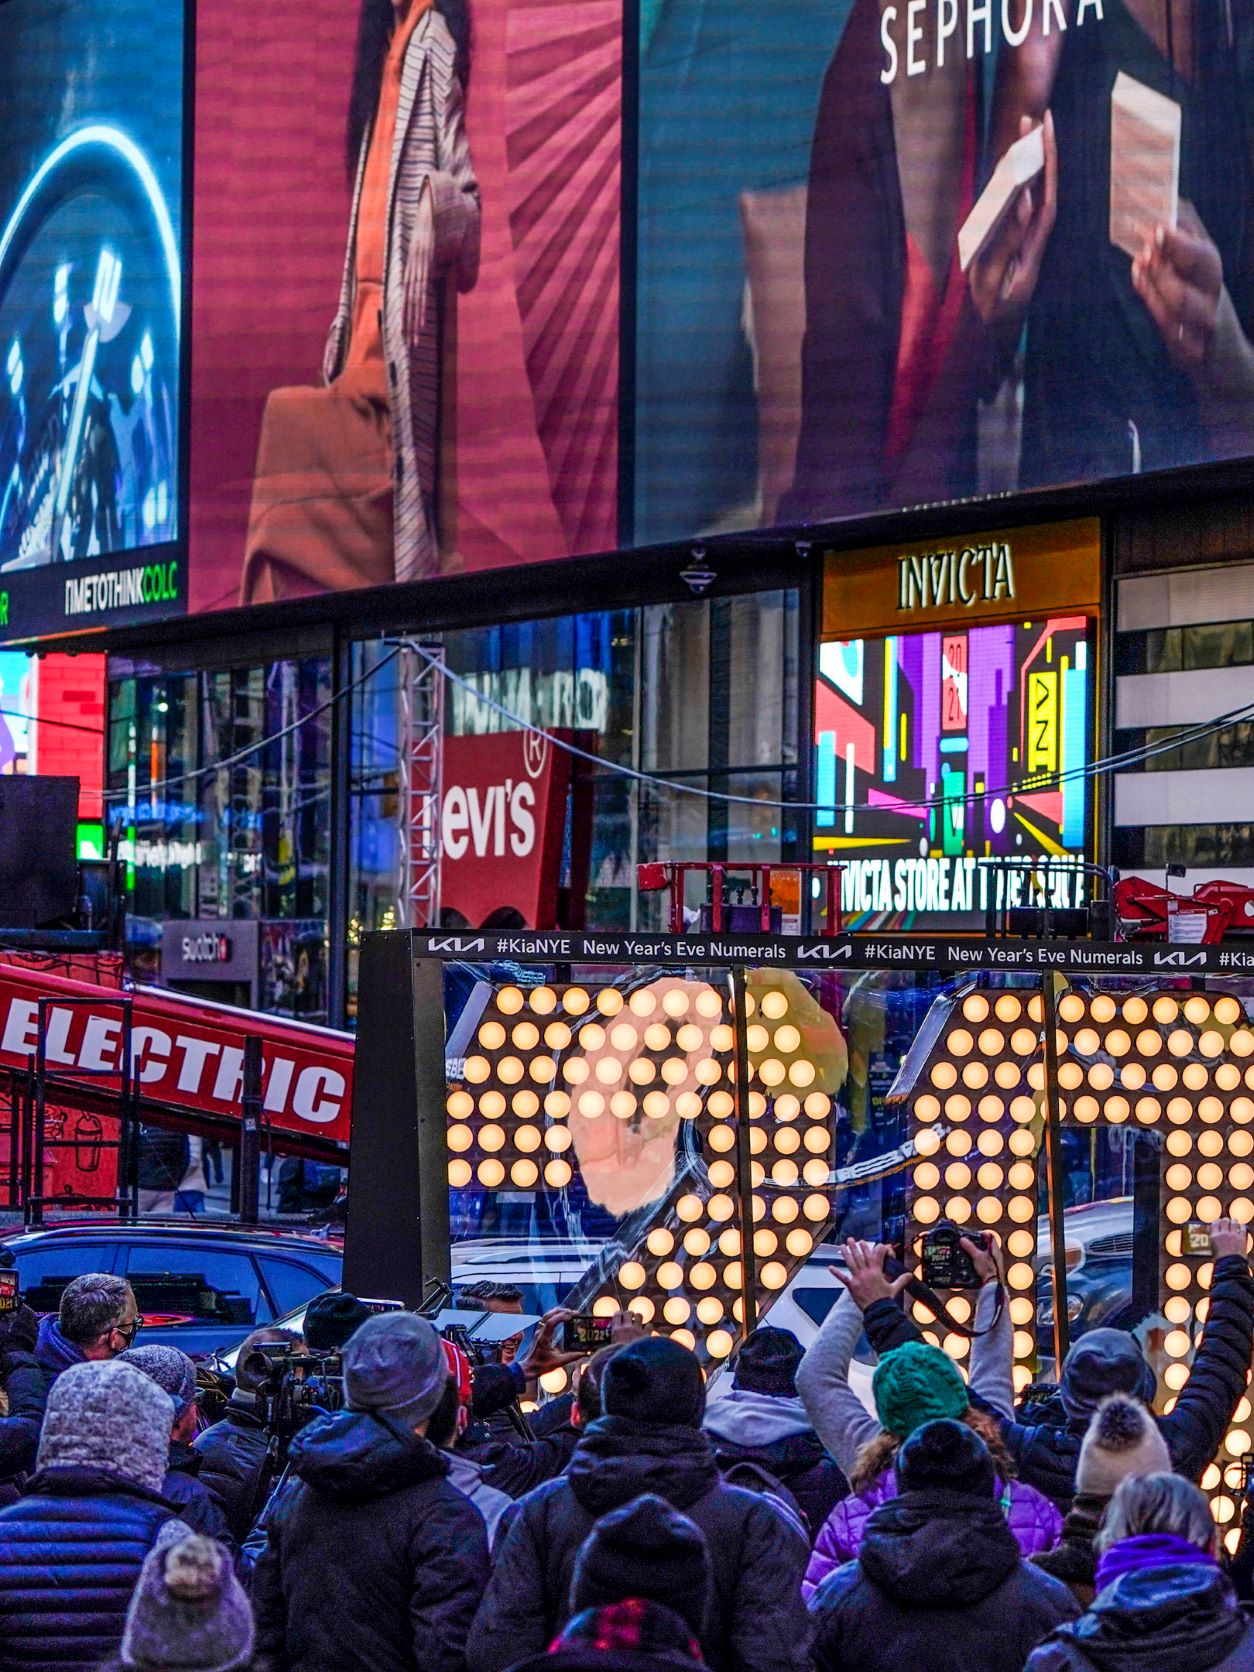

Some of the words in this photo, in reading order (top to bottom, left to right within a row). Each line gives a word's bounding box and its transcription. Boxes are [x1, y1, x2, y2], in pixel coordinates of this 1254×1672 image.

[898, 543, 1016, 611] INVICTA
[894, 858, 950, 912] STORE
[951, 857, 977, 911] AT
[497, 938, 571, 954] #KiaNYE
[583, 940, 620, 956] New
[624, 940, 672, 956] Year's
[677, 942, 706, 957] Eve
[710, 942, 786, 958] Numerals
[864, 945, 936, 960] #KiaNYE
[948, 946, 983, 962] New
[987, 947, 1033, 963] Year's
[1038, 948, 1066, 963] Eve
[1070, 949, 1143, 965] Numerals
[1, 997, 346, 1123] ELECTRIC
